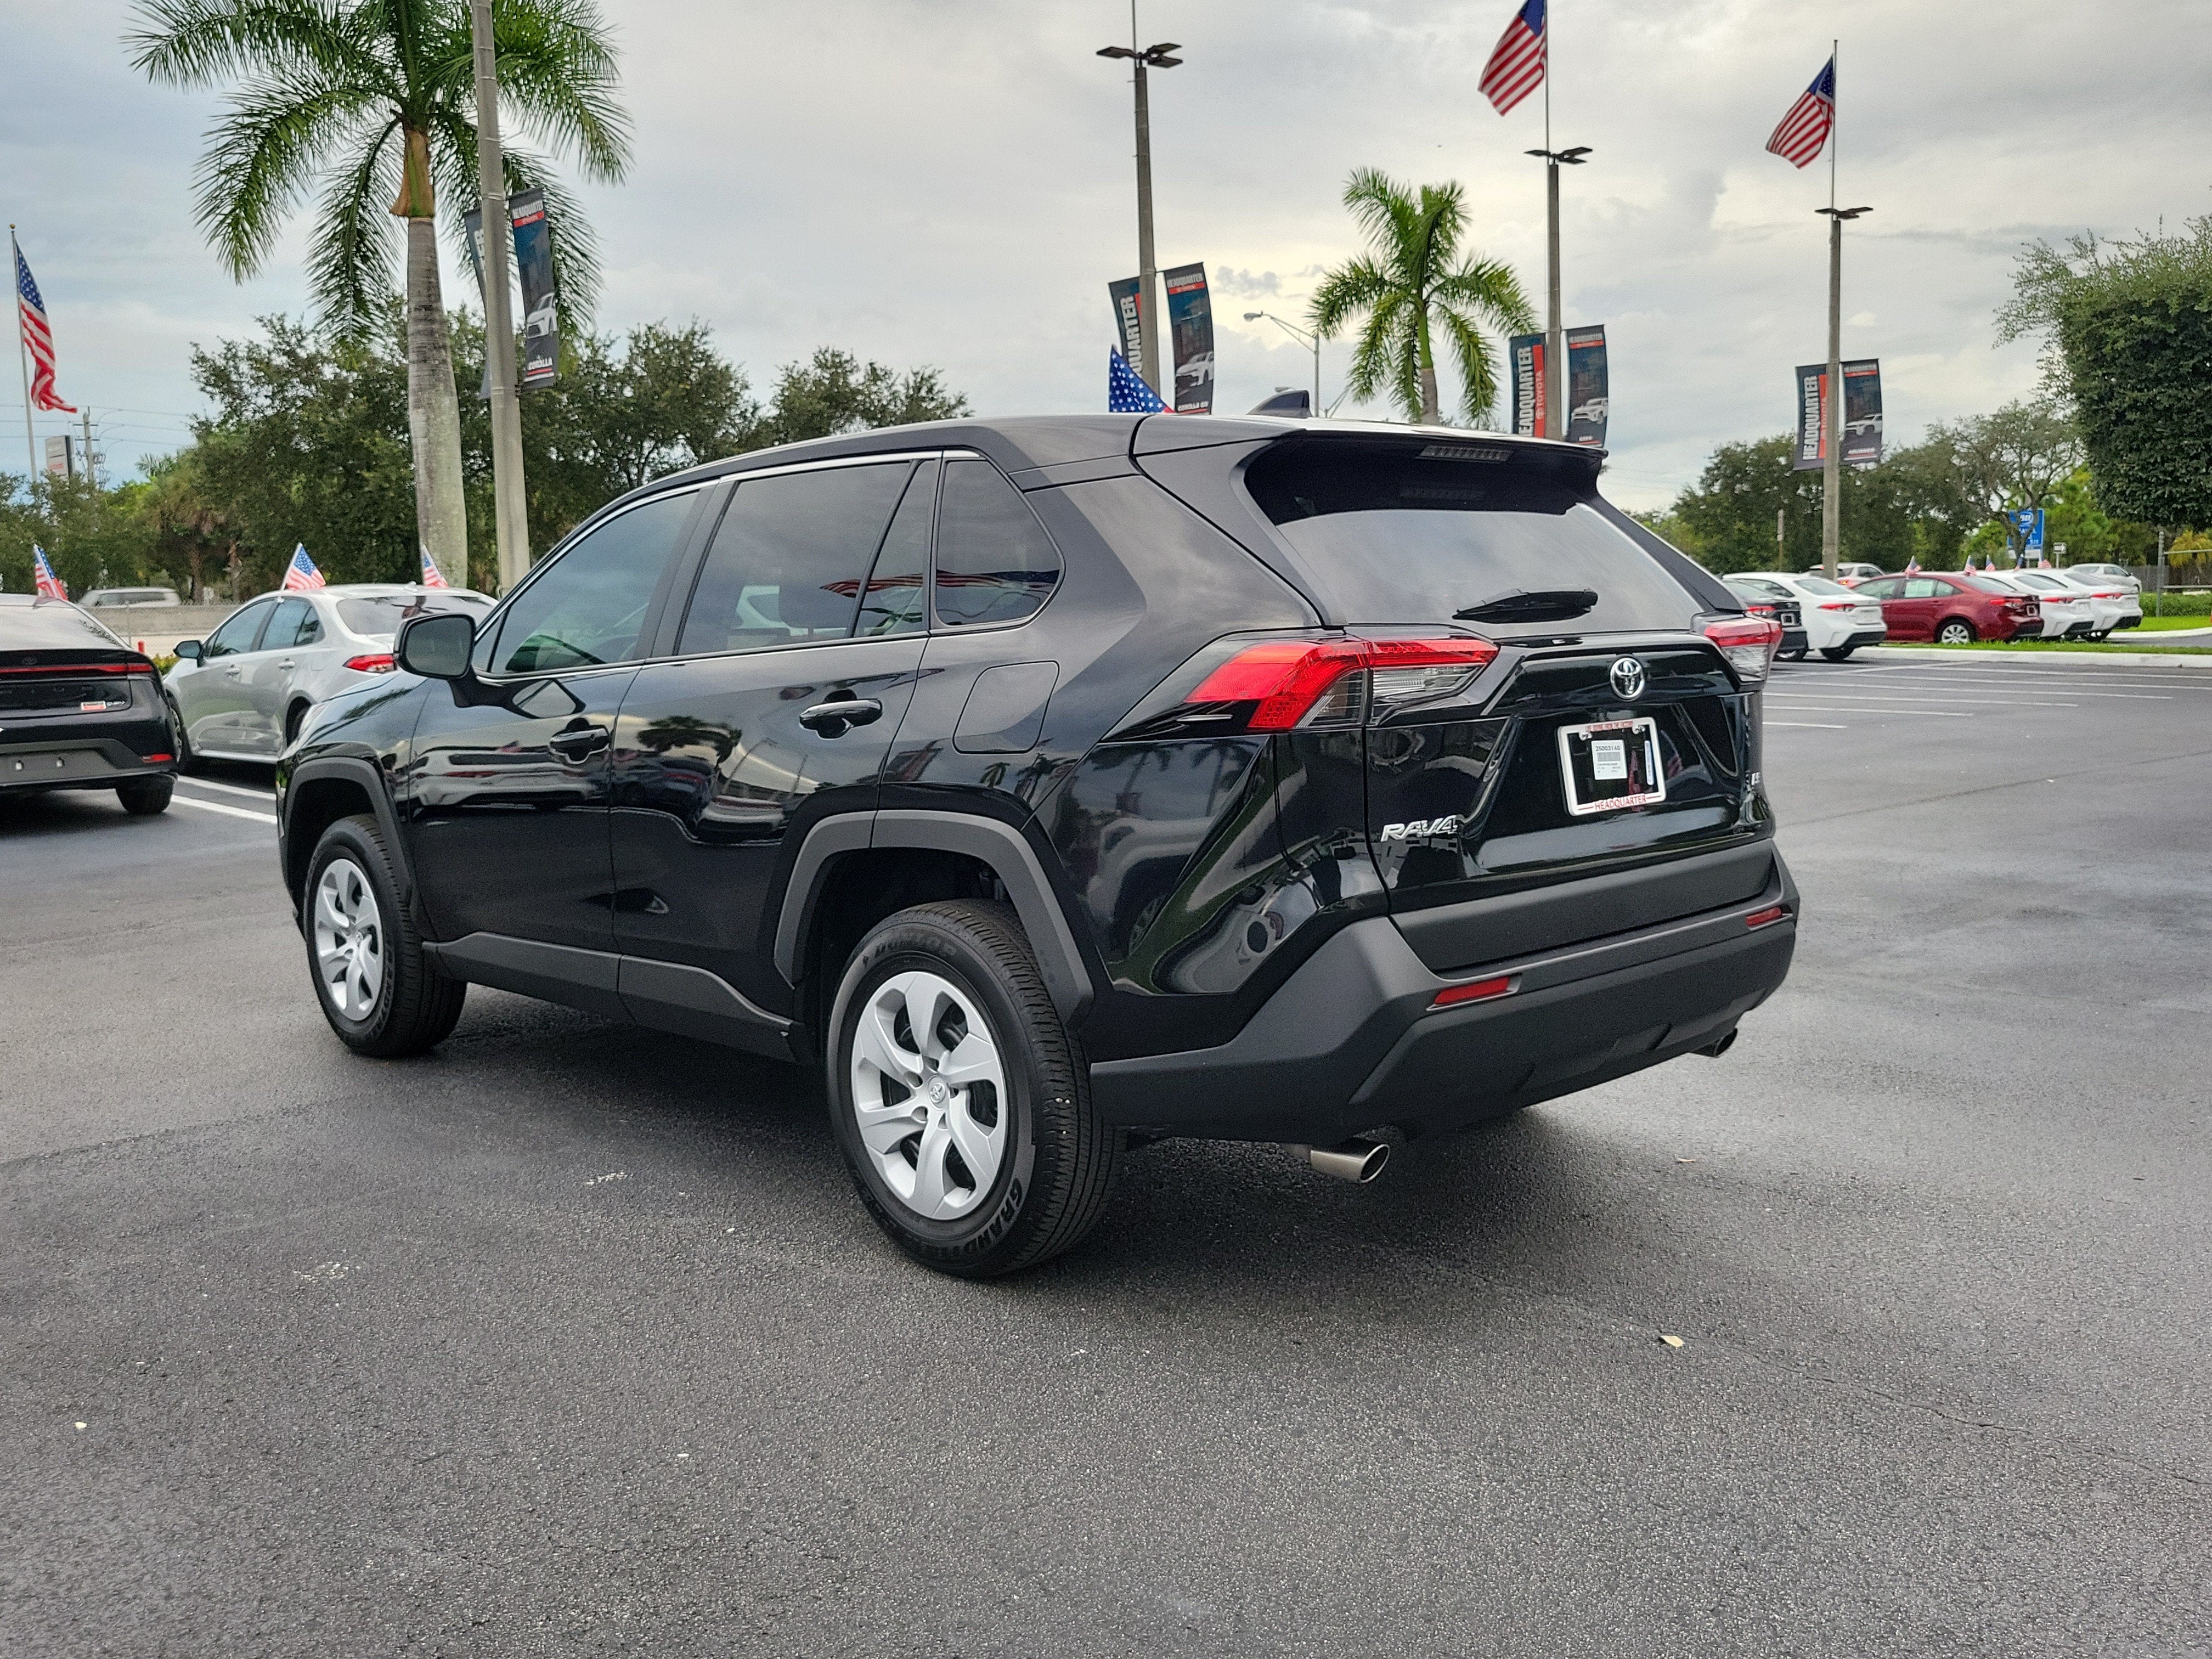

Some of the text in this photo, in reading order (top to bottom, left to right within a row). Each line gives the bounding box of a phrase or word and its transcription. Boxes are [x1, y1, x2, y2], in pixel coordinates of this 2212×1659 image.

[1120, 296, 1143, 377] QUARTER
[1802, 376, 1820, 460] HEADQUARTER
[1380, 815, 1458, 842] RAV4
[1595, 795, 1646, 810] HEADQUARTER
